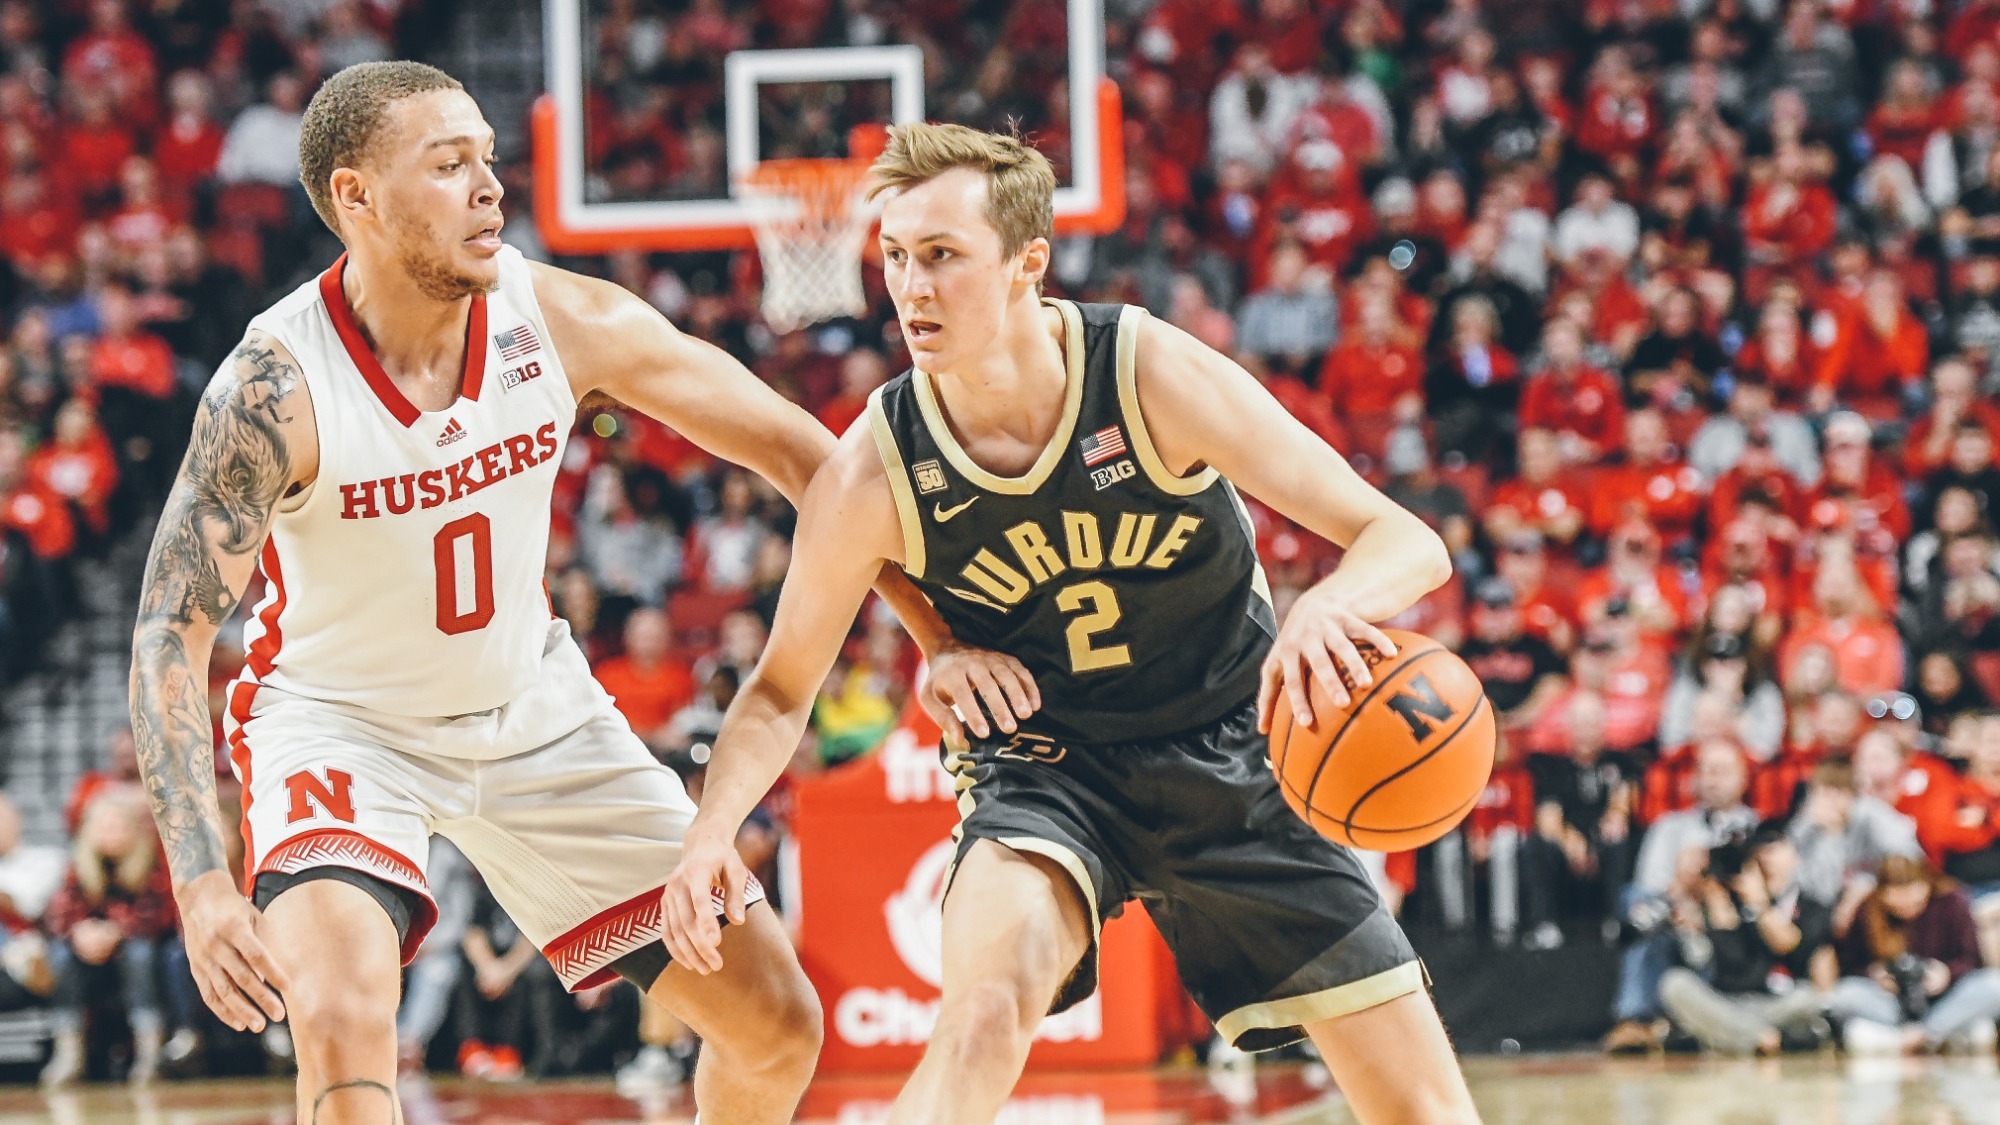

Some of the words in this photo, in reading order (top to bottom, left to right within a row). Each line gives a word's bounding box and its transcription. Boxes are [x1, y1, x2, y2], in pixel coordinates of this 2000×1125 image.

[339, 420, 558, 520] HUSKERS
[436, 430, 467, 447] adidas
[916, 468, 944, 491] 50
[433, 511, 496, 636] 0
[943, 509, 1203, 614] PURDUE
[1055, 580, 1133, 676] 2
[1384, 672, 1455, 744] N
[284, 765, 357, 826] N
